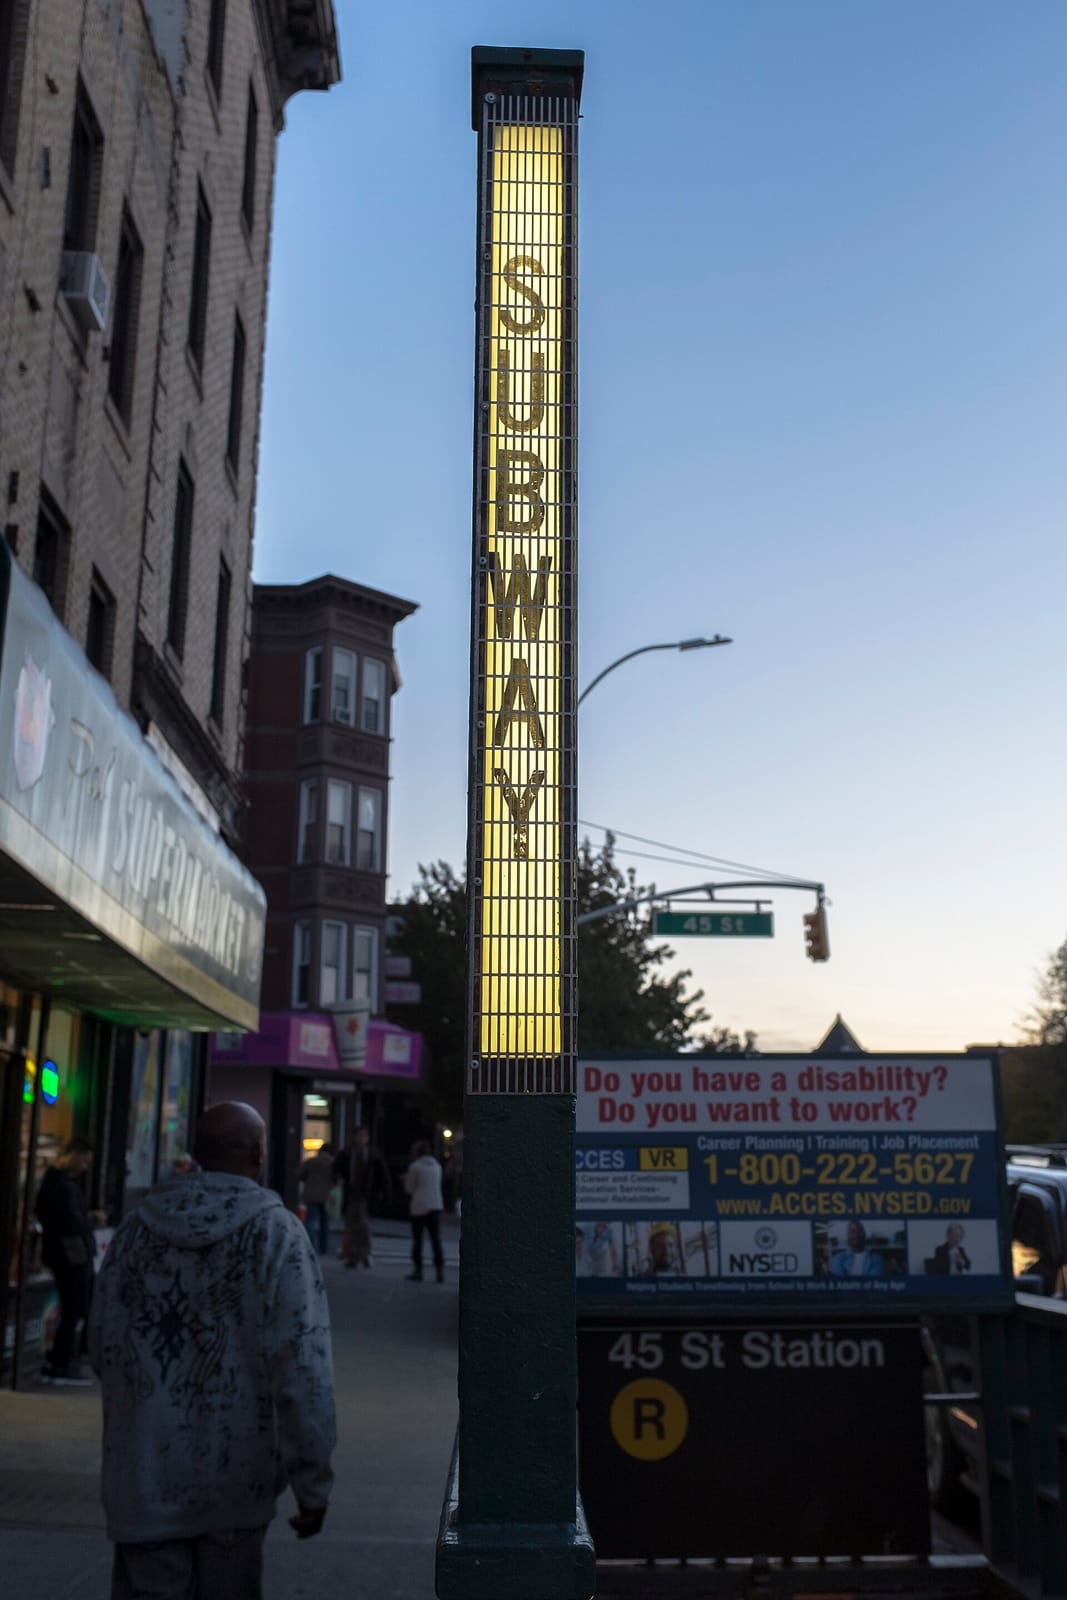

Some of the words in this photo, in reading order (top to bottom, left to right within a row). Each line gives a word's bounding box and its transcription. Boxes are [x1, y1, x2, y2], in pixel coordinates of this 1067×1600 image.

[488, 253, 553, 860] SUBWAY
[683, 917, 712, 933] 45
[720, 917, 744, 933] St
[584, 1066, 621, 1092] Do
[630, 1071, 682, 1098] you
[692, 1065, 761, 1092] have
[770, 1071, 787, 1092] a
[797, 1064, 949, 1097] disability?
[598, 1097, 635, 1122] Do
[645, 1101, 697, 1128] you
[707, 1097, 781, 1122] want
[790, 1097, 818, 1121] to
[828, 1096, 918, 1121] work?
[648, 1149, 676, 1167] VR
[697, 1135, 742, 1150] Career
[745, 1135, 804, 1153] Planning
[816, 1135, 869, 1153] Training
[880, 1135, 905, 1150] Job
[908, 1135, 980, 1150] Placement
[704, 1153, 975, 1185] 1-800-222-5627
[729, 1252, 798, 1273] NYSED
[608, 1331, 664, 1369] 45
[681, 1330, 726, 1369] St
[741, 1330, 885, 1369] Station
[633, 1397, 666, 1440] R
